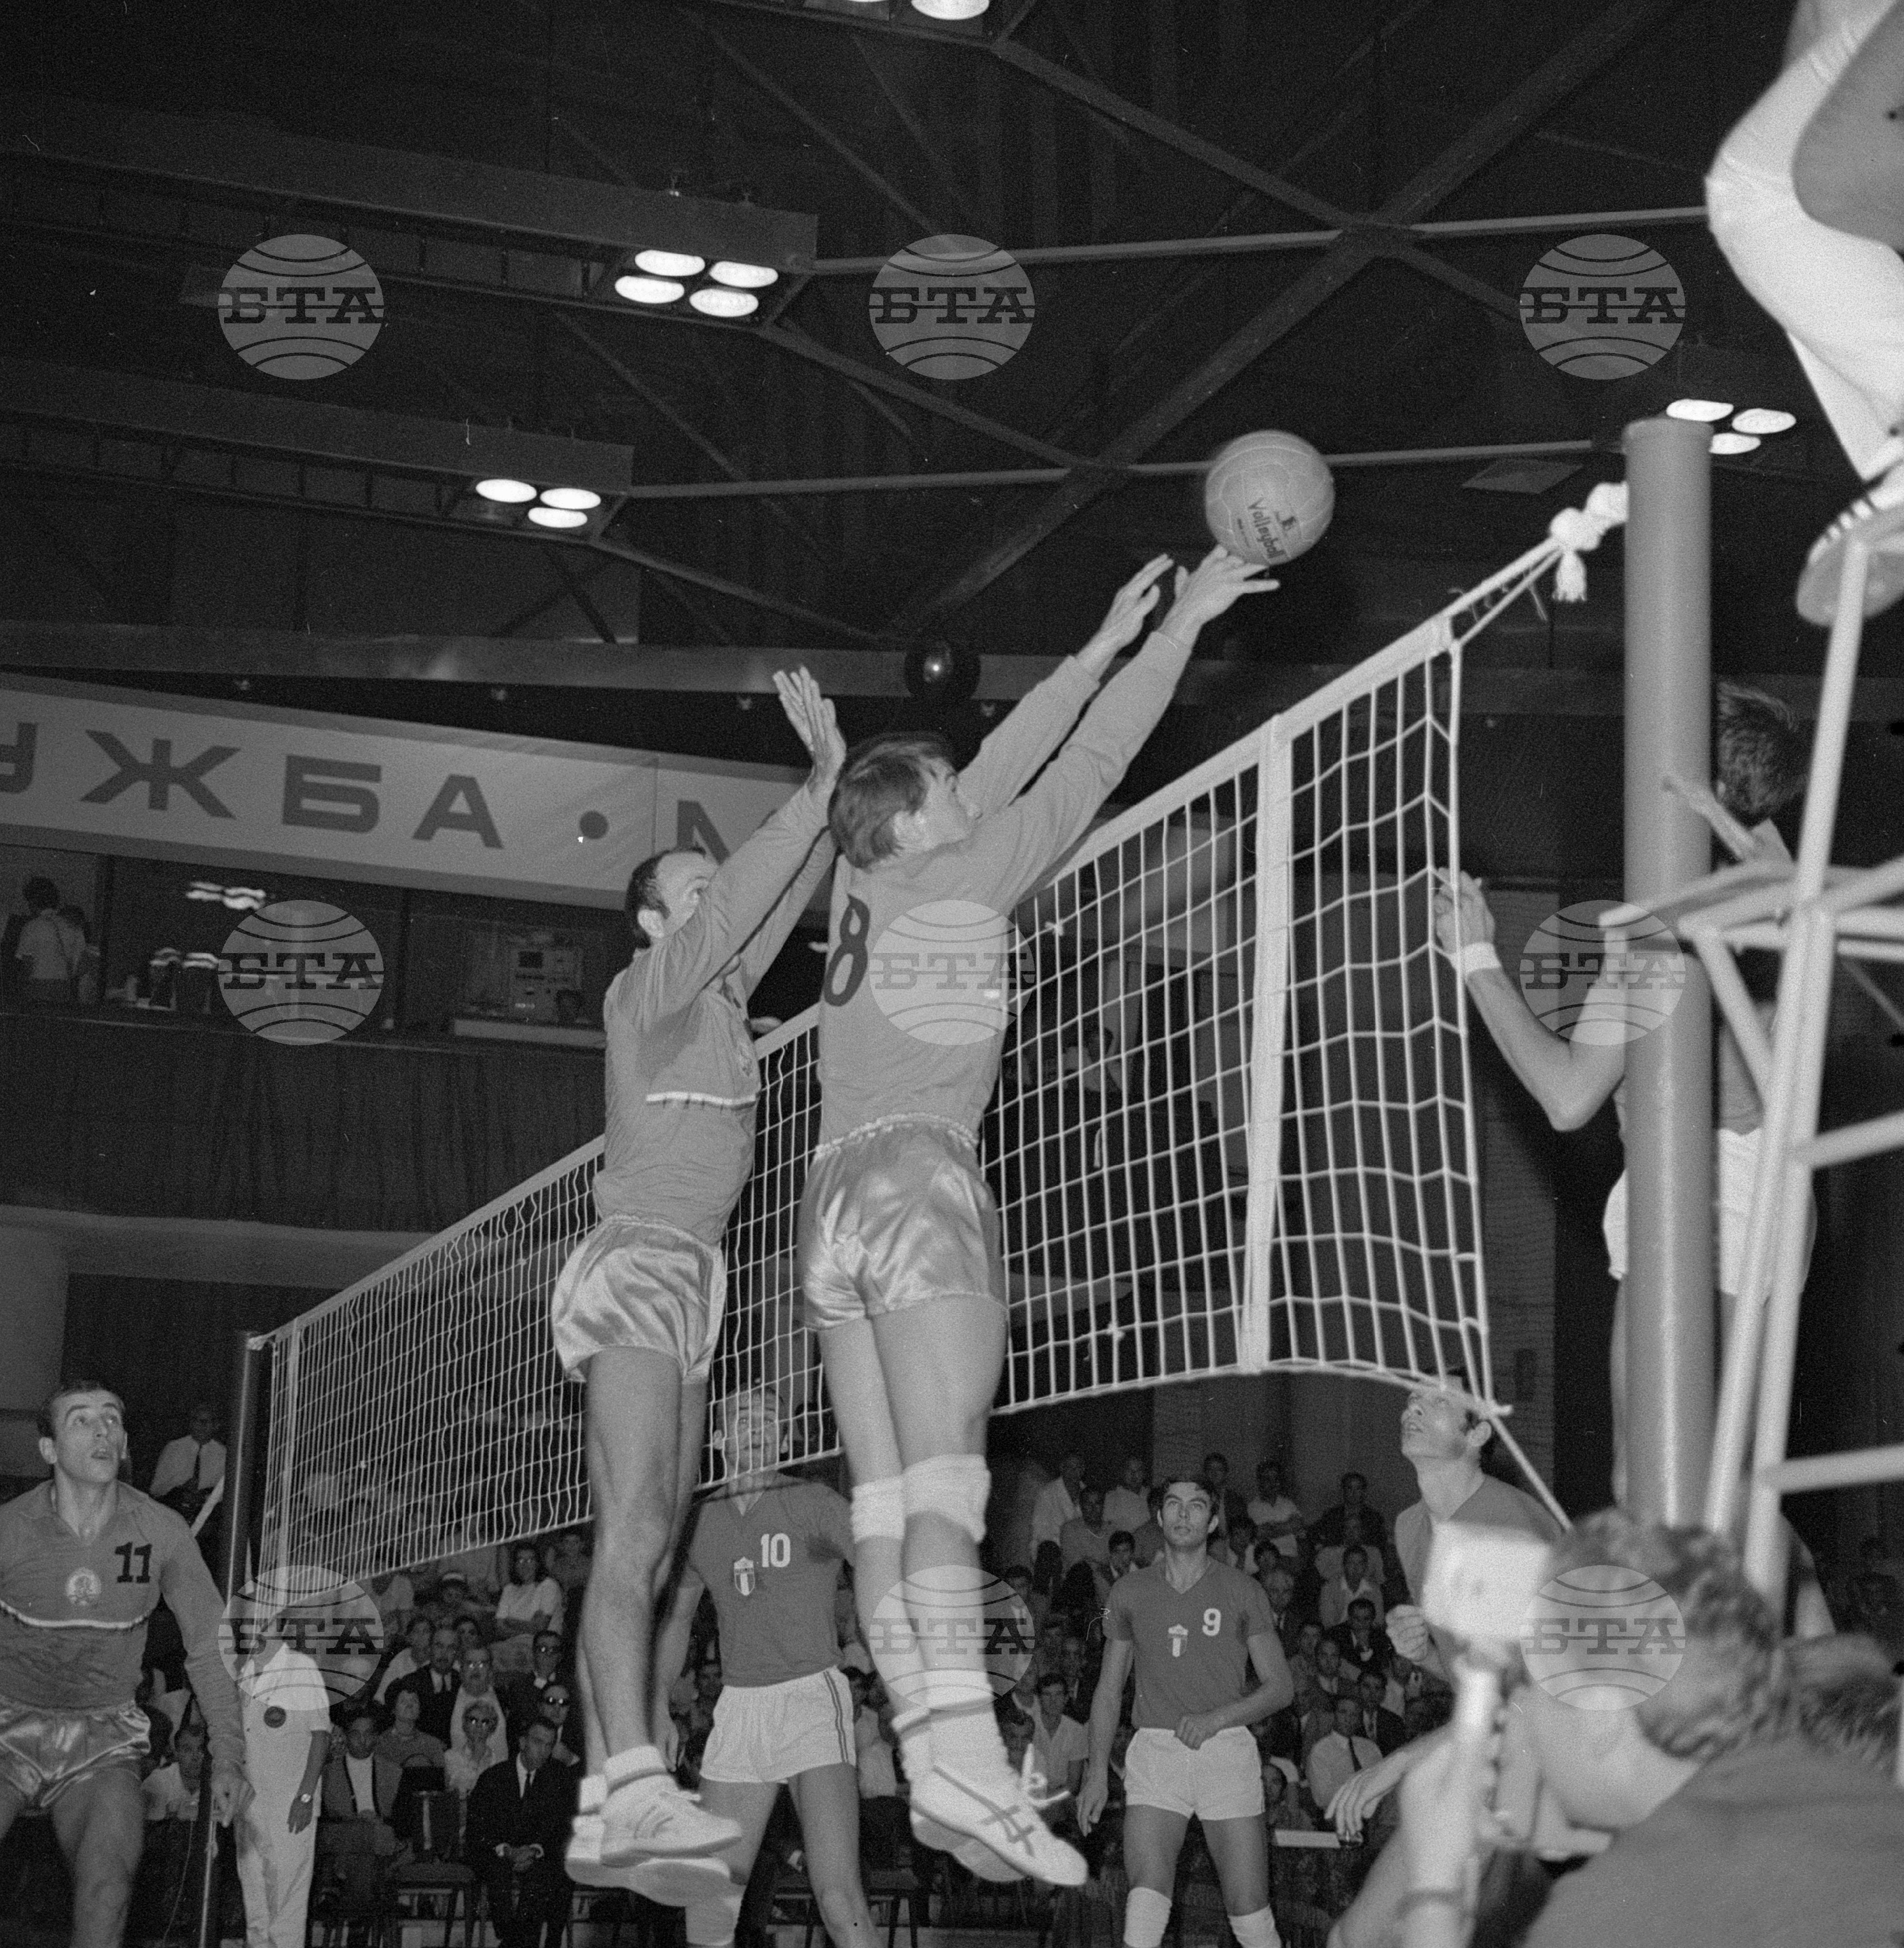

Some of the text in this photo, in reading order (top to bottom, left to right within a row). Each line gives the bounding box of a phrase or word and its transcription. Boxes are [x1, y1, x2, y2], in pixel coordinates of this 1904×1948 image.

[823, 893, 871, 1007] 8
[114, 1541, 152, 1583] 11
[761, 1533, 791, 1568] 10
[1202, 1608, 1221, 1636] 9
